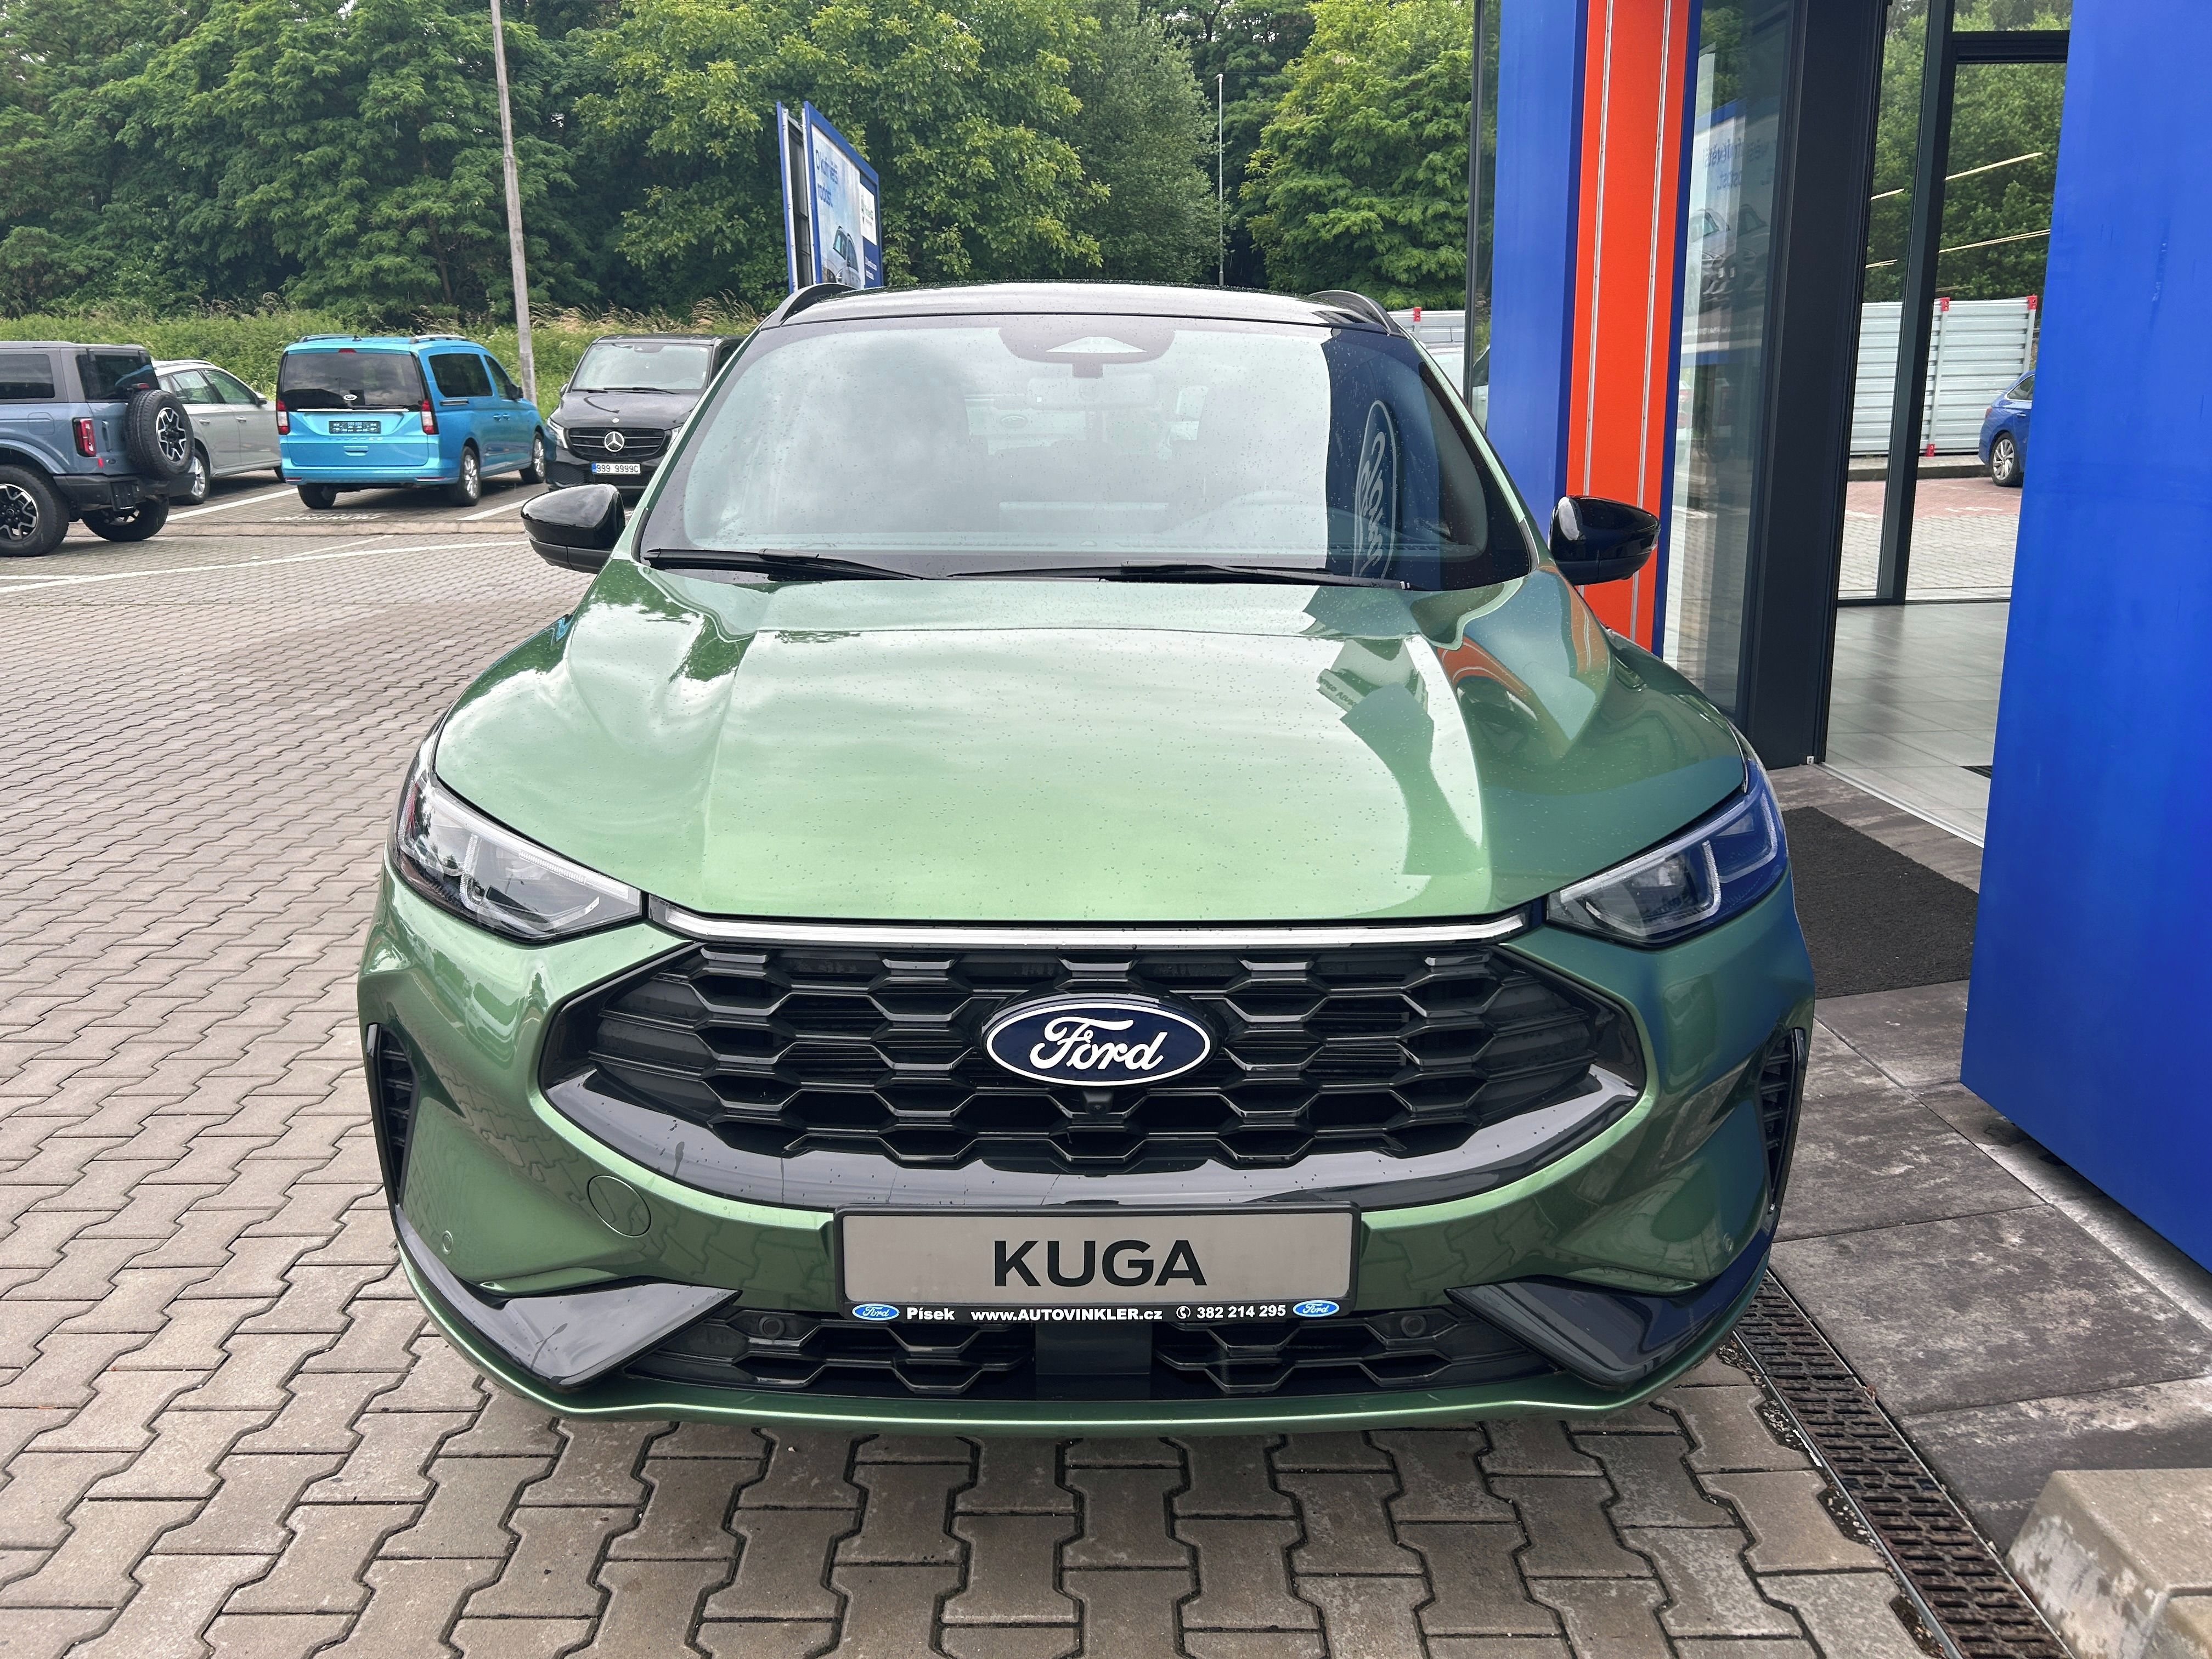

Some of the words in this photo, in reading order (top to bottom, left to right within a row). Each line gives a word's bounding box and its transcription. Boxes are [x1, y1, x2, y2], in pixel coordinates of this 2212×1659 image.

[1029, 1016, 1168, 1070] Ford
[994, 1240, 1206, 1286] KUGA
[862, 1306, 890, 1318] Ford
[907, 1307, 955, 1320] Písek
[971, 1308, 1163, 1321] www.AUTOVINKLER.cz
[1197, 1306, 1223, 1319] 382
[1228, 1306, 1255, 1318] 214
[1259, 1305, 1286, 1317] 295
[1302, 1303, 1329, 1314] Ford
